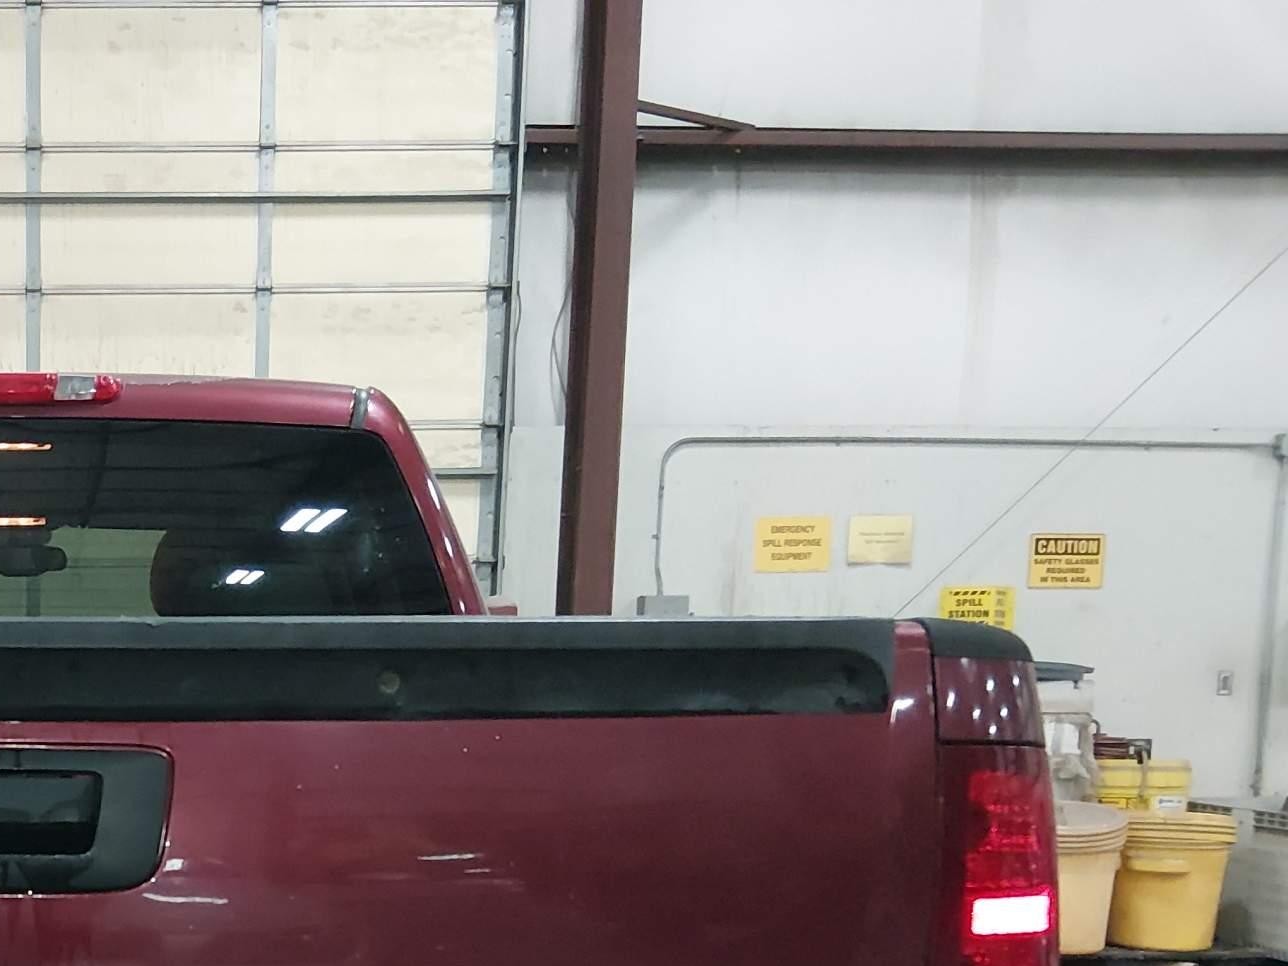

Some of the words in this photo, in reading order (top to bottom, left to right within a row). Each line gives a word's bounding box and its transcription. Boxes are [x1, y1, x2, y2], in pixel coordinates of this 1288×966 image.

[770, 525, 815, 534] EMERGENCY
[762, 539, 782, 548] SPILL
[783, 538, 823, 547] RESPONSE
[1036, 539, 1100, 554] CAUTION
[770, 552, 813, 561] EQUIPMENT
[955, 598, 984, 607] SPILL
[947, 610, 990, 618] STATION
